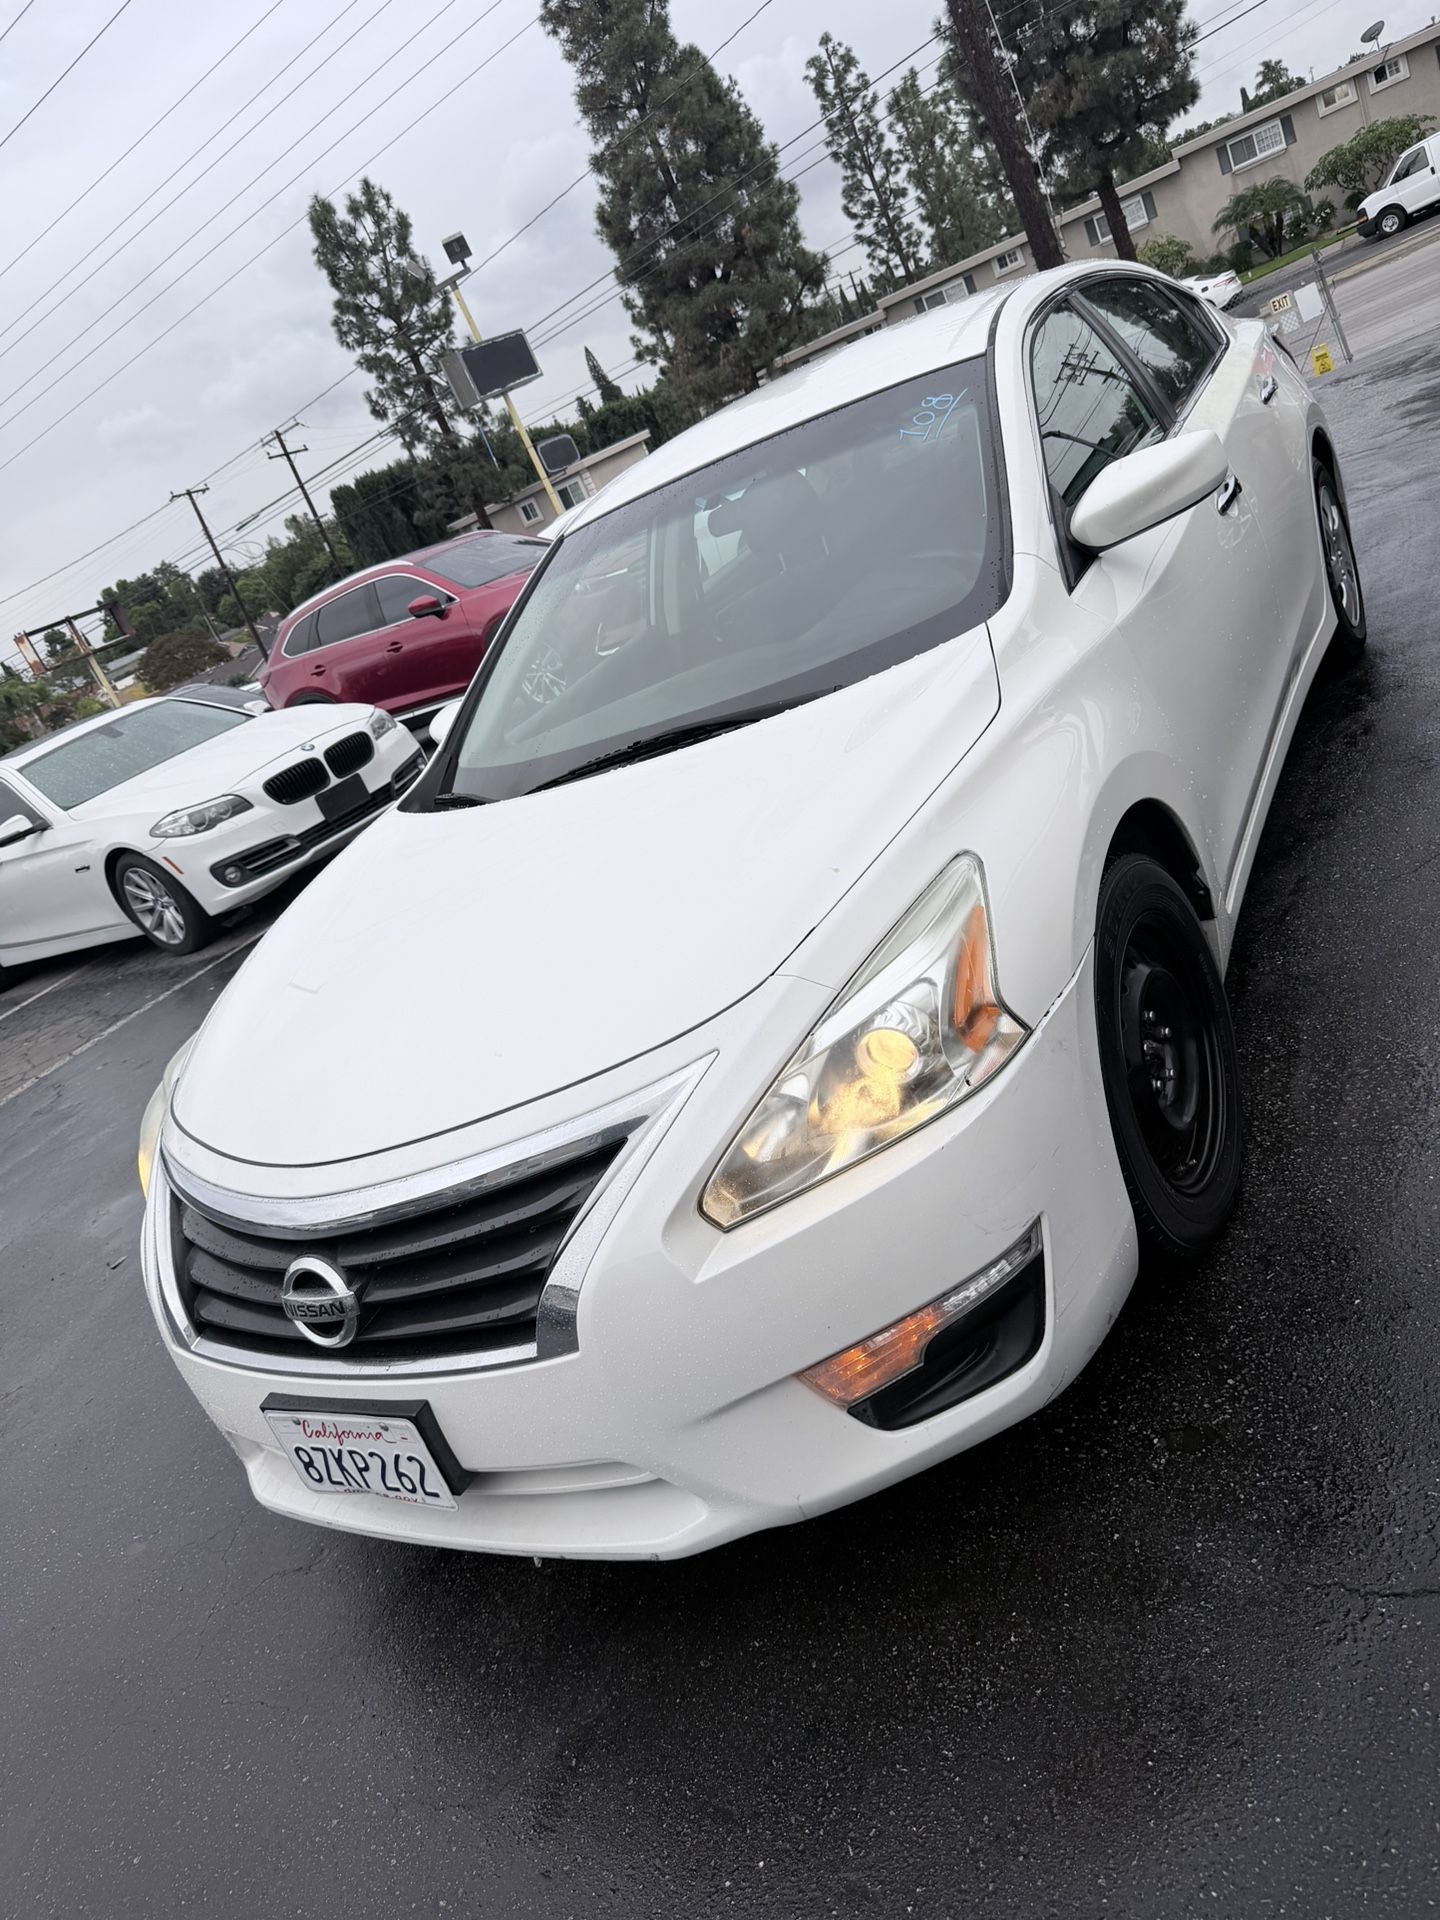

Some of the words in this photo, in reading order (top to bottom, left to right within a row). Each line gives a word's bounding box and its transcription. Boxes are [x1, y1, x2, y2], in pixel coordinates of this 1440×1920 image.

[1271, 295, 1290, 312] EXIT
[284, 1301, 346, 1318] NISSAN
[301, 1419, 397, 1446] California
[294, 1446, 440, 1498] 8ZKP262
[343, 1487, 418, 1503] dmca.gov
